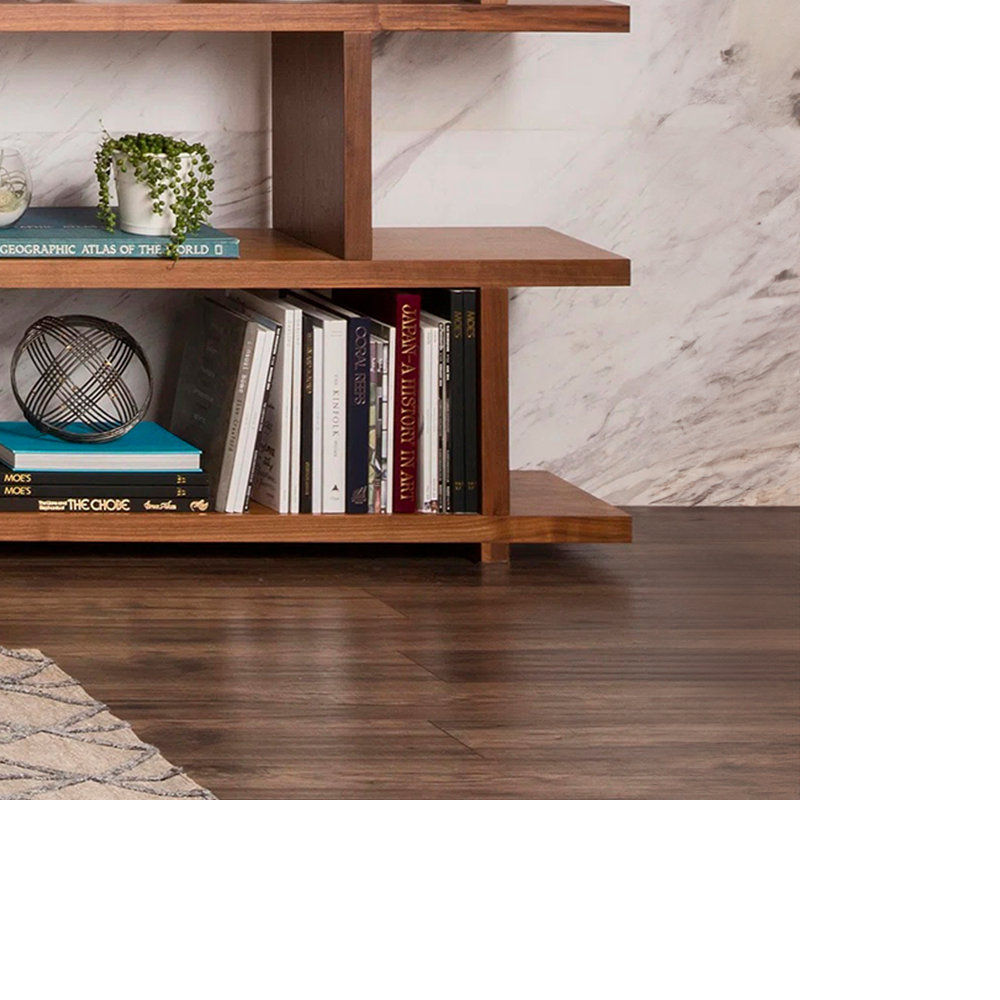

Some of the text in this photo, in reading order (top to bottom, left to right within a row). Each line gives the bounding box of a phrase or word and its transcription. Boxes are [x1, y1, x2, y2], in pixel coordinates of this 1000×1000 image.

[0, 244, 76, 255] GEOGRAPHIC
[81, 244, 116, 255] ATLAS
[119, 244, 136, 255] OF
[138, 244, 162, 255] THE
[354, 325, 367, 406] CORAL REEFS
[332, 390, 340, 437] KINFOLK
[401, 377, 416, 447] HISTORY
[400, 449, 415, 468] IN
[399, 470, 415, 502] ART
[67, 498, 90, 511] THE
